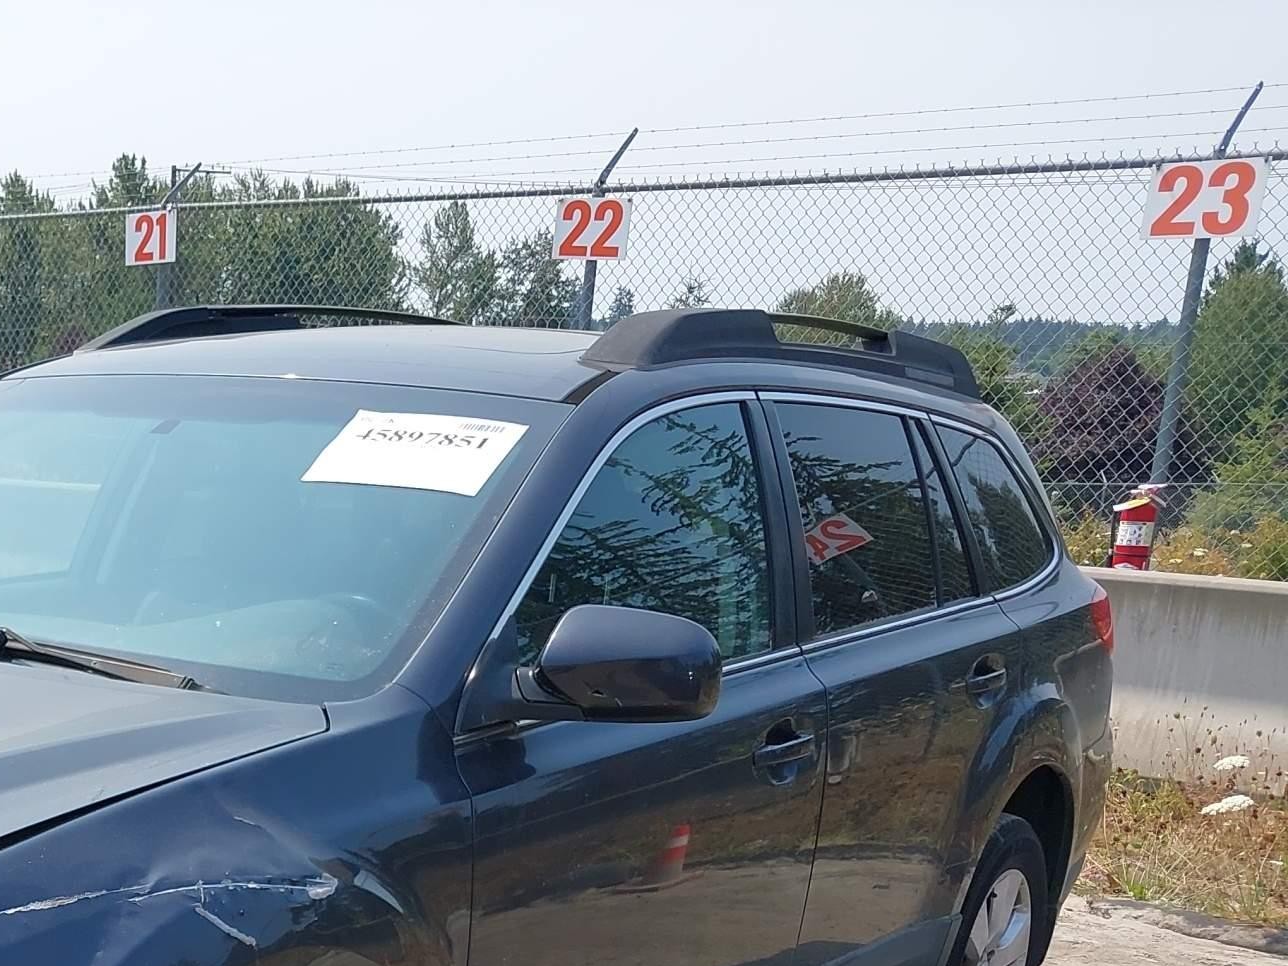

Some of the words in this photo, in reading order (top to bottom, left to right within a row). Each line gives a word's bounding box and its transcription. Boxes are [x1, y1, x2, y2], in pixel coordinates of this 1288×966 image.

[1150, 161, 1256, 236] 23
[135, 213, 167, 262] 21
[559, 200, 623, 257] 22
[356, 428, 490, 449] 45897851
